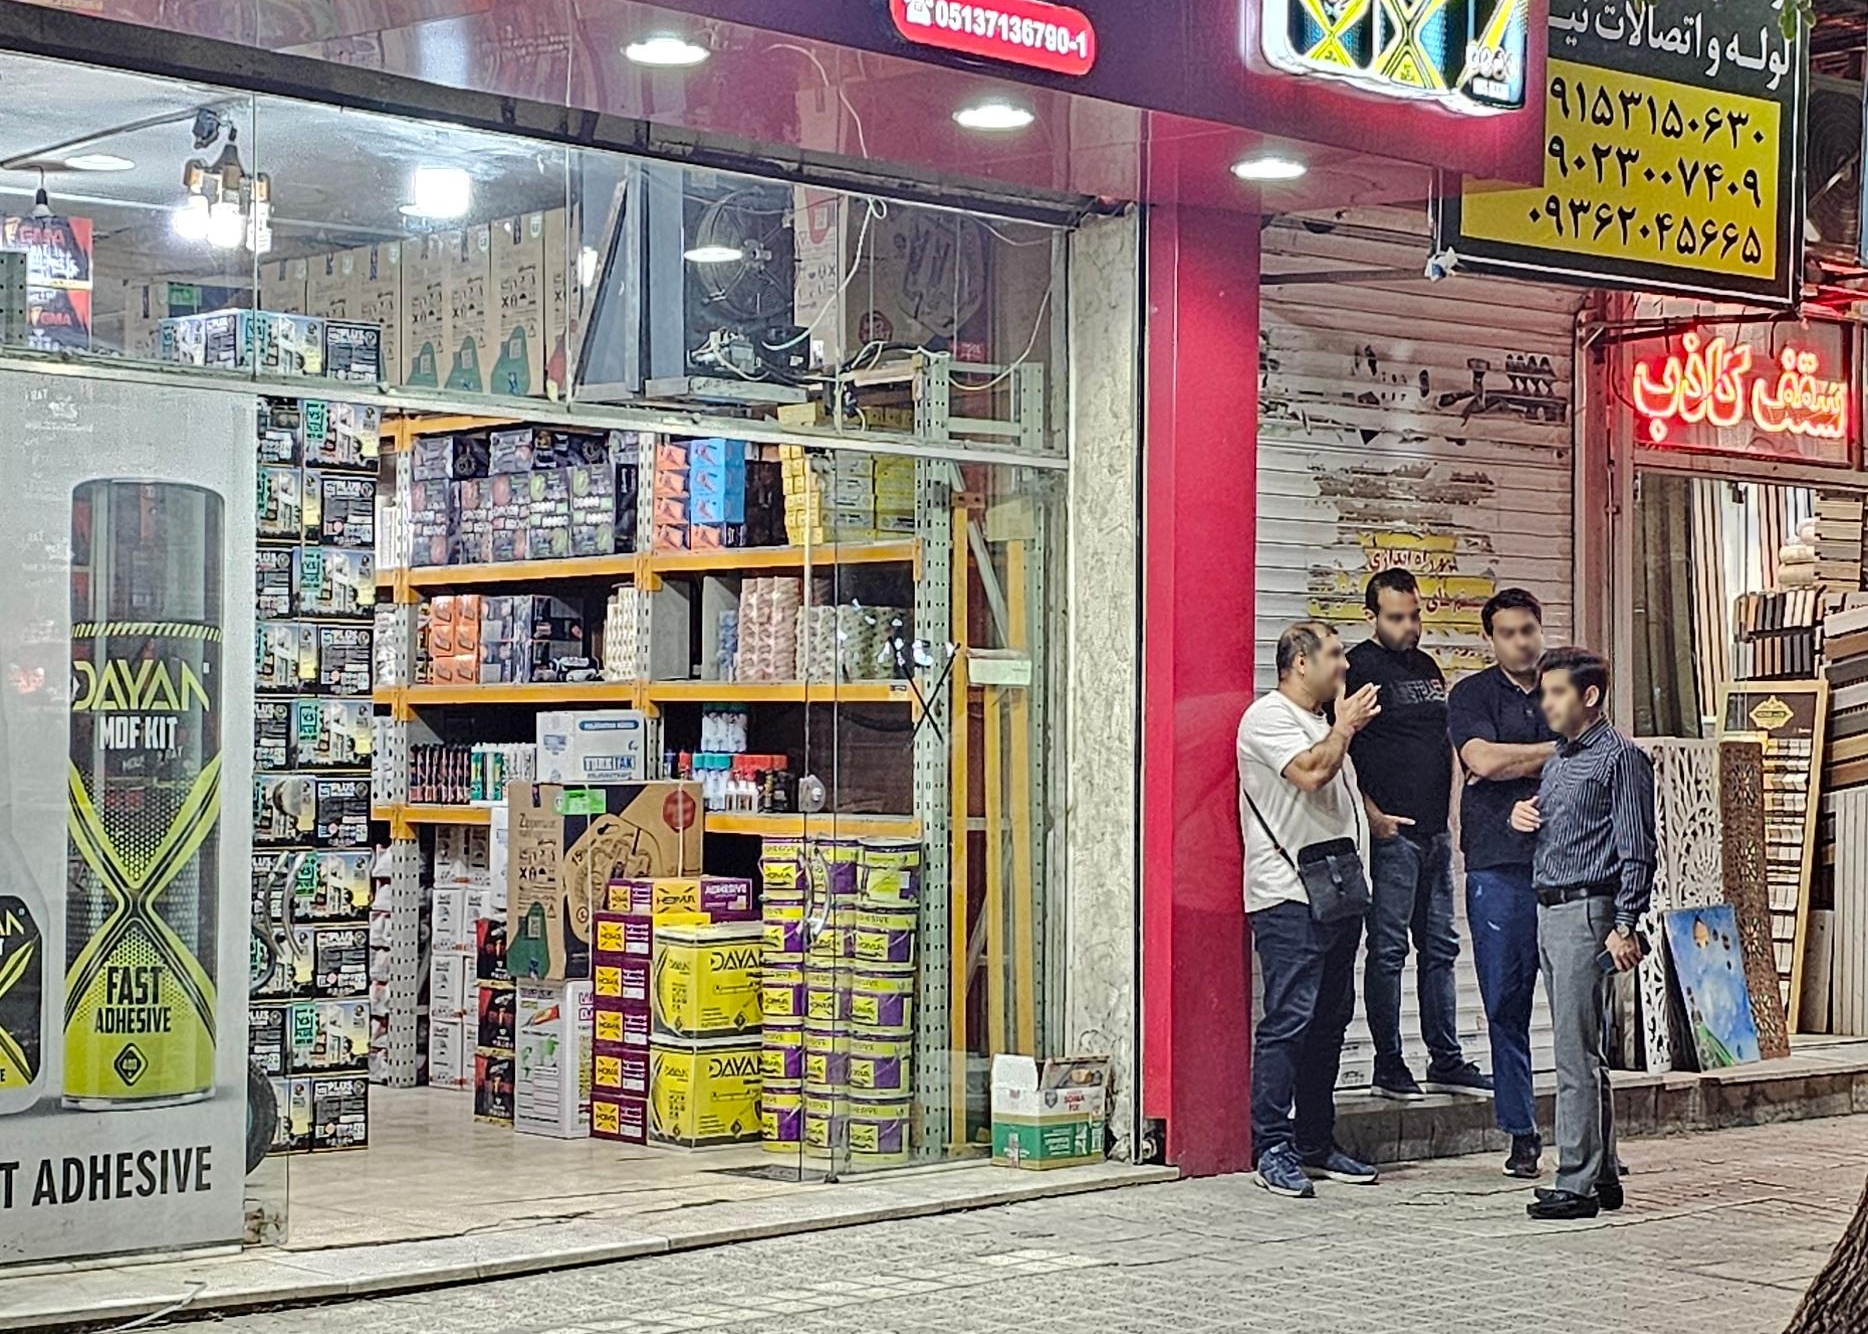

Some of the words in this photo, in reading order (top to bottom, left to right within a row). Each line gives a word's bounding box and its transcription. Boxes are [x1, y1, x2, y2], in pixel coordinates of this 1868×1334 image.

[1596, 0, 1702, 58] اتصالات
[1529, 194, 1763, 264] ۰۹۳۶۲۰۴۵۶۶۵
[1634, 331, 1751, 442] کاذب
[72, 658, 211, 713] DAYAN
[100, 715, 141, 750] MDF
[144, 715, 178, 750] KIT
[106, 966, 164, 1005] FAST
[94, 1007, 172, 1034] ADHESIVE
[32, 1145, 213, 1208] ADHESIVE
